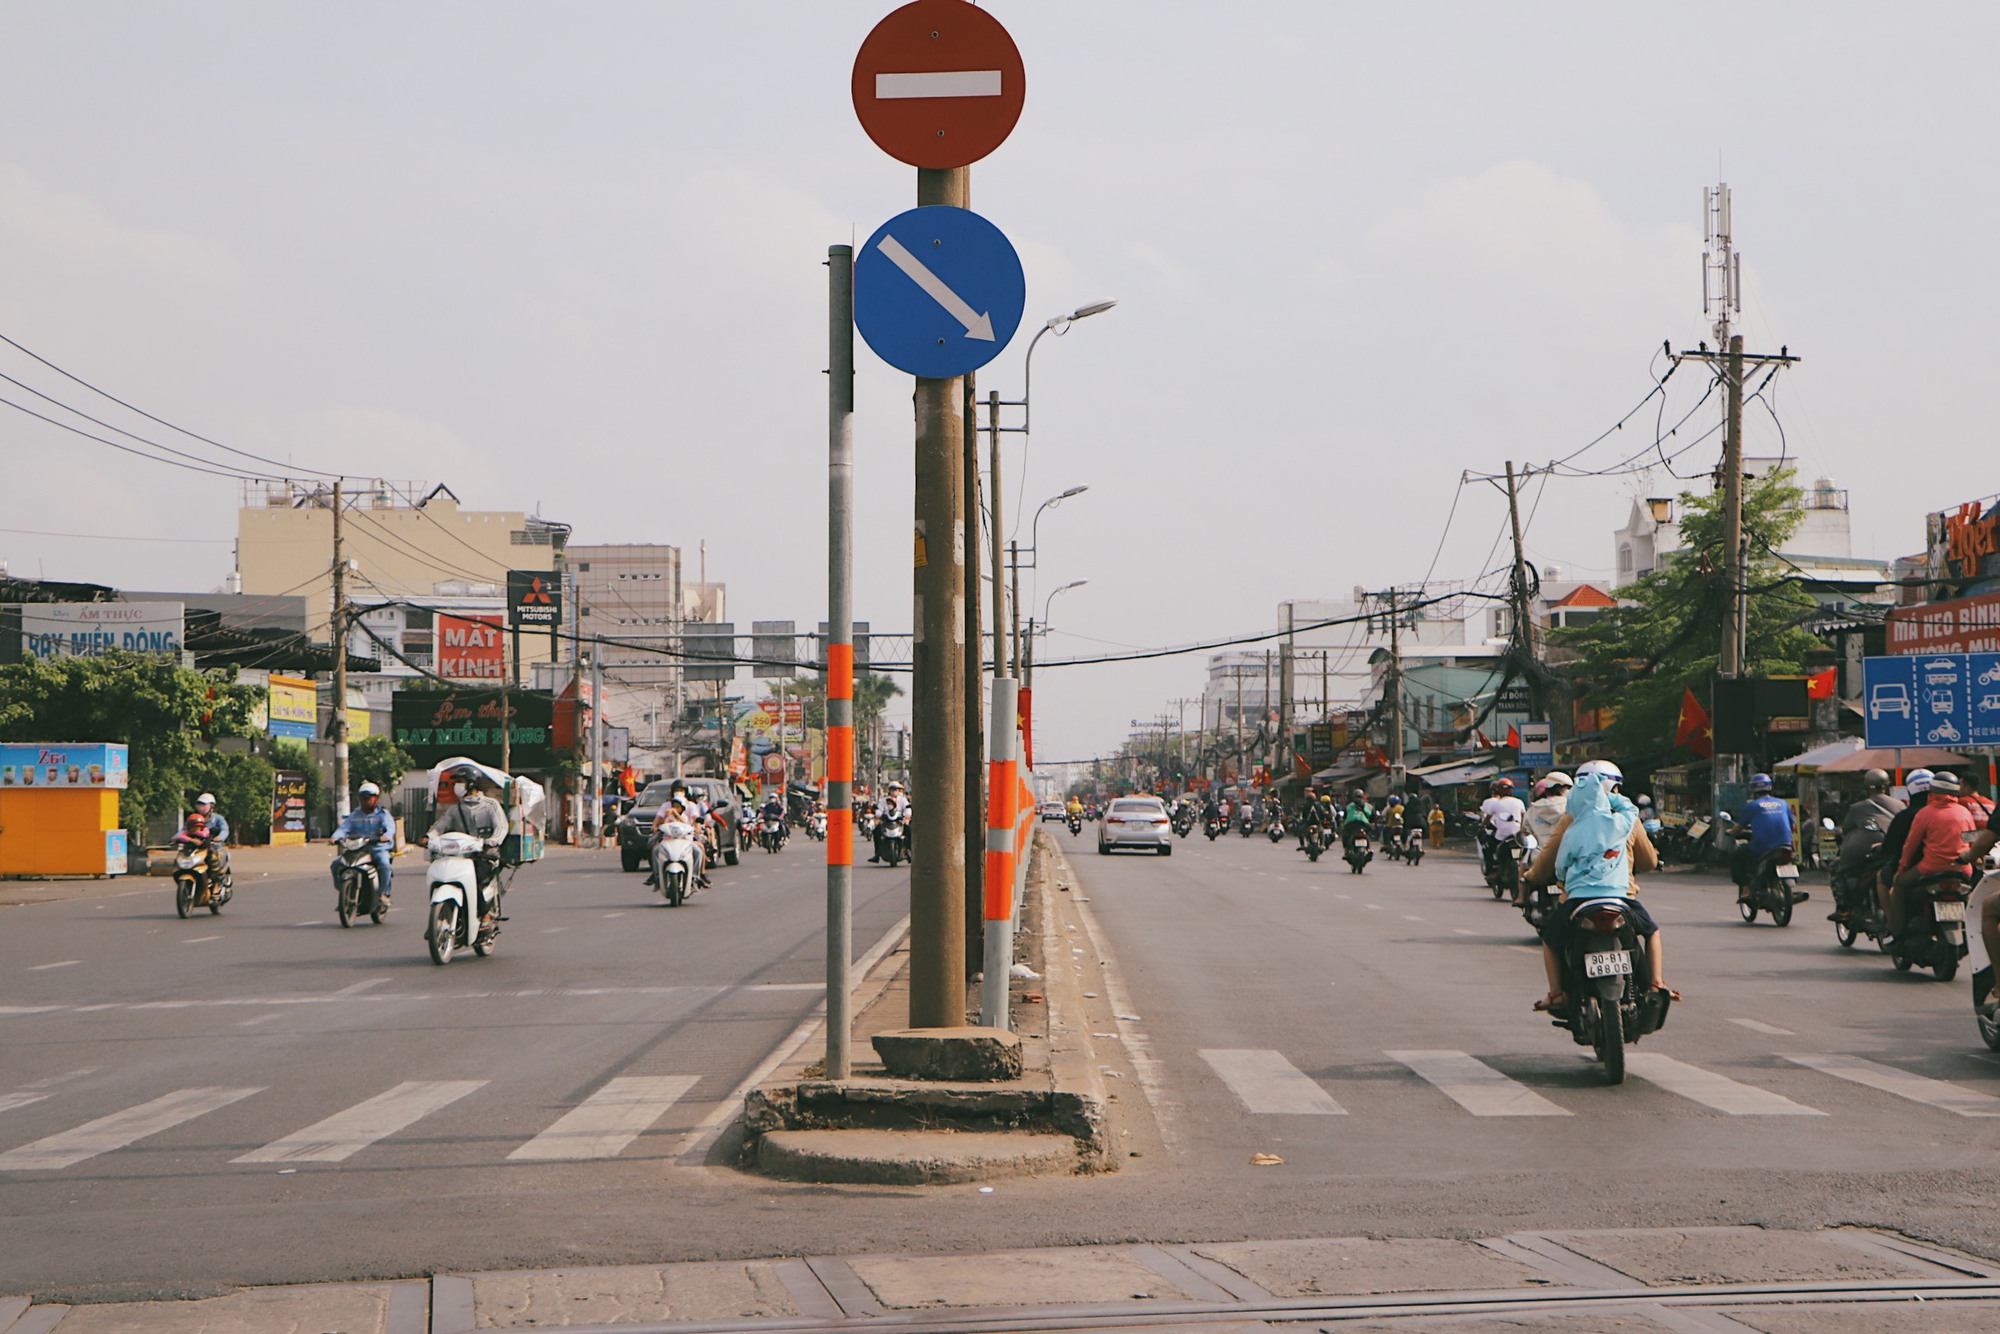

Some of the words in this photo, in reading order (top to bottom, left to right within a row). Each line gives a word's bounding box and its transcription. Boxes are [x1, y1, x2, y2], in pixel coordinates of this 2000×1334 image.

[103, 609, 143, 621] THỰC
[516, 605, 558, 613] MITSUBISHI
[1893, 612, 1919, 642] MÁ
[1923, 611, 1954, 639] HEO
[1959, 602, 2000, 634] BÌNH
[445, 616, 497, 647] MẮT
[122, 626, 175, 656] ĐÔNG
[441, 650, 500, 677] KÍNH
[396, 728, 433, 746] RAY
[38, 750, 67, 765] Z61
[1591, 953, 1623, 965] 90-B1
